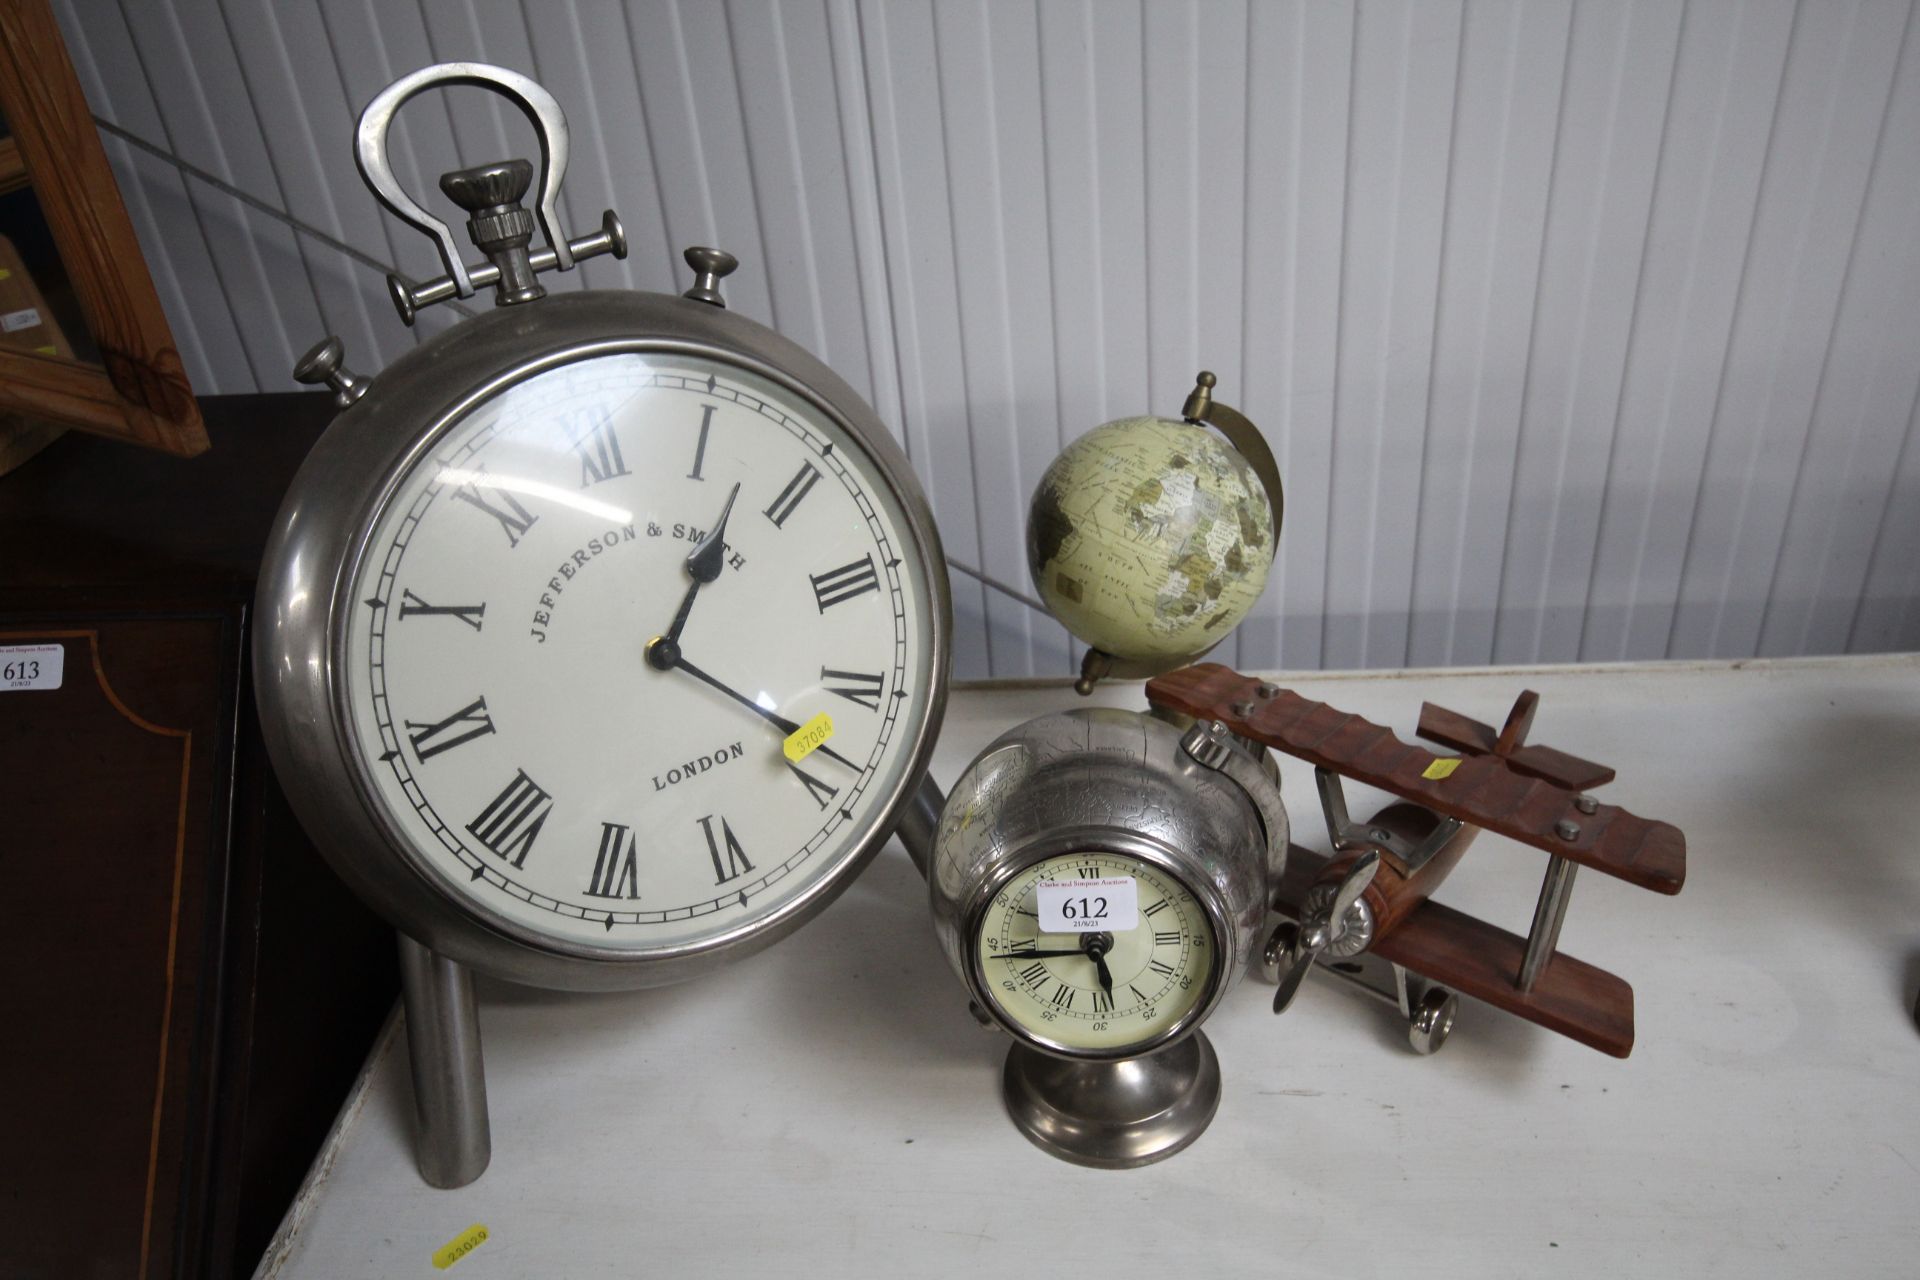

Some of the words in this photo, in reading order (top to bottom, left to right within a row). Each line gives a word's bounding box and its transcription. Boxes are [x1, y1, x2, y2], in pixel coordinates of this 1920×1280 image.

[686, 404, 718, 481] I
[450, 463, 539, 548] XI
[762, 459, 824, 530] II
[531, 522, 636, 643] JEFFERSON
[647, 522, 662, 537] &
[672, 523, 747, 572] SMTH
[809, 553, 880, 614] III
[399, 588, 486, 631] X
[3, 661, 40, 680] 613
[821, 665, 886, 712] IV
[405, 696, 496, 764] IX
[795, 720, 832, 754] 37084
[651, 741, 746, 792] LONDON
[785, 761, 838, 811] V
[465, 768, 553, 870] VIII
[582, 822, 641, 900] VII
[697, 814, 756, 886] VI
[1039, 880, 1059, 888] Clarke
[1061, 880, 1072, 888] and
[1073, 880, 1100, 888] Simpson
[1101, 878, 1129, 886] Auctions
[1062, 897, 1109, 919] 612
[1143, 899, 1170, 917] II
[987, 937, 998, 951] 45
[1155, 931, 1181, 946] III
[1019, 960, 1052, 991] VIII
[1149, 959, 1175, 980] IV
[1179, 975, 1192, 990] 20
[1051, 984, 1076, 1009] VII
[1129, 983, 1147, 1003] V
[1092, 1021, 1109, 1031] 30
[1142, 1007, 1157, 1021] 25
